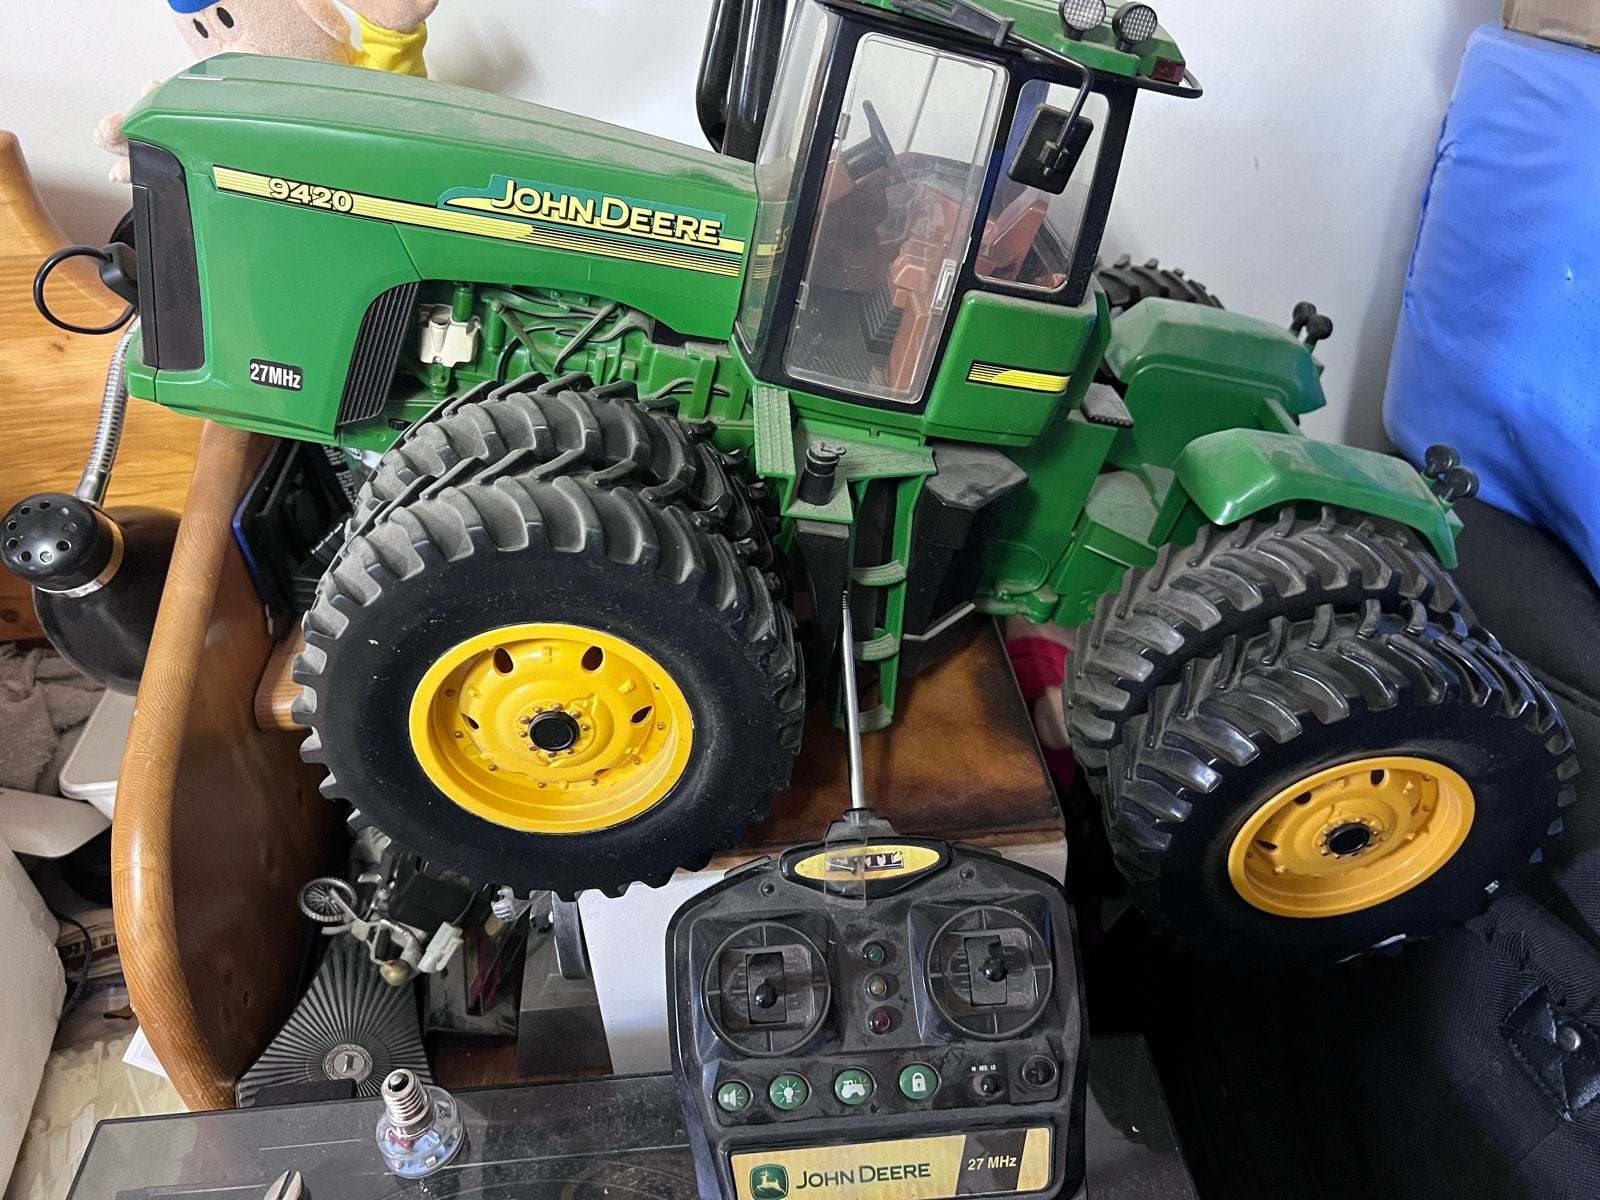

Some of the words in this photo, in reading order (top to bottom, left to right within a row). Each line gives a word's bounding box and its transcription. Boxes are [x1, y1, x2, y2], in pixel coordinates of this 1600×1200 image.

[268, 177, 353, 213] 9420
[491, 179, 595, 224] JOHN
[599, 196, 722, 246] DEERE
[250, 363, 301, 389] 27MHz
[796, 1169, 854, 1189] JOHN
[858, 1163, 931, 1184] DEERE
[967, 1158, 984, 1171] 27
[987, 1155, 1017, 1169] MHz
